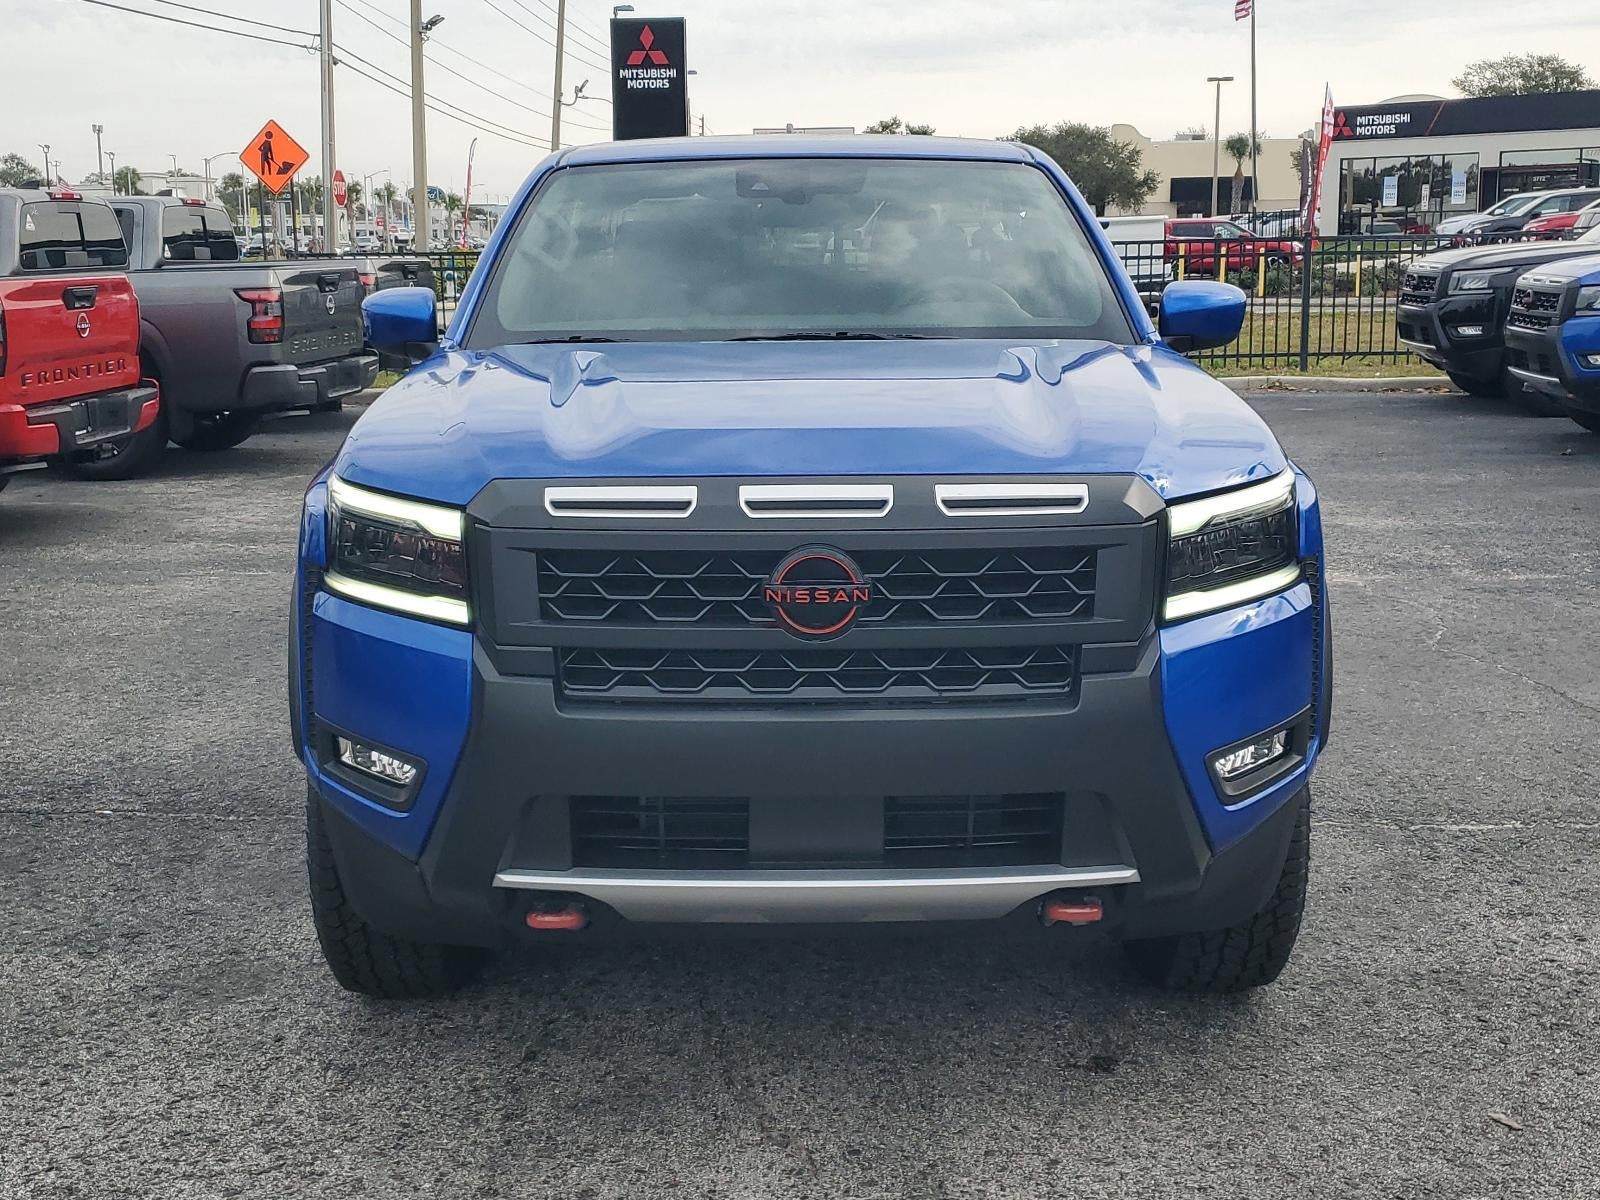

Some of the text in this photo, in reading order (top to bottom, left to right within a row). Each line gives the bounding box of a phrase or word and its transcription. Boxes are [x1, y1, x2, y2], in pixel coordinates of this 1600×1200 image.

[619, 68, 677, 79] MITSUBISHI
[627, 79, 670, 89] MOTORS
[1356, 112, 1411, 126] MITSUBISHI
[1356, 124, 1396, 136] MOTORS
[333, 181, 347, 196] STOP
[20, 358, 128, 389] FRONTIER
[765, 589, 869, 603] NISSAN
